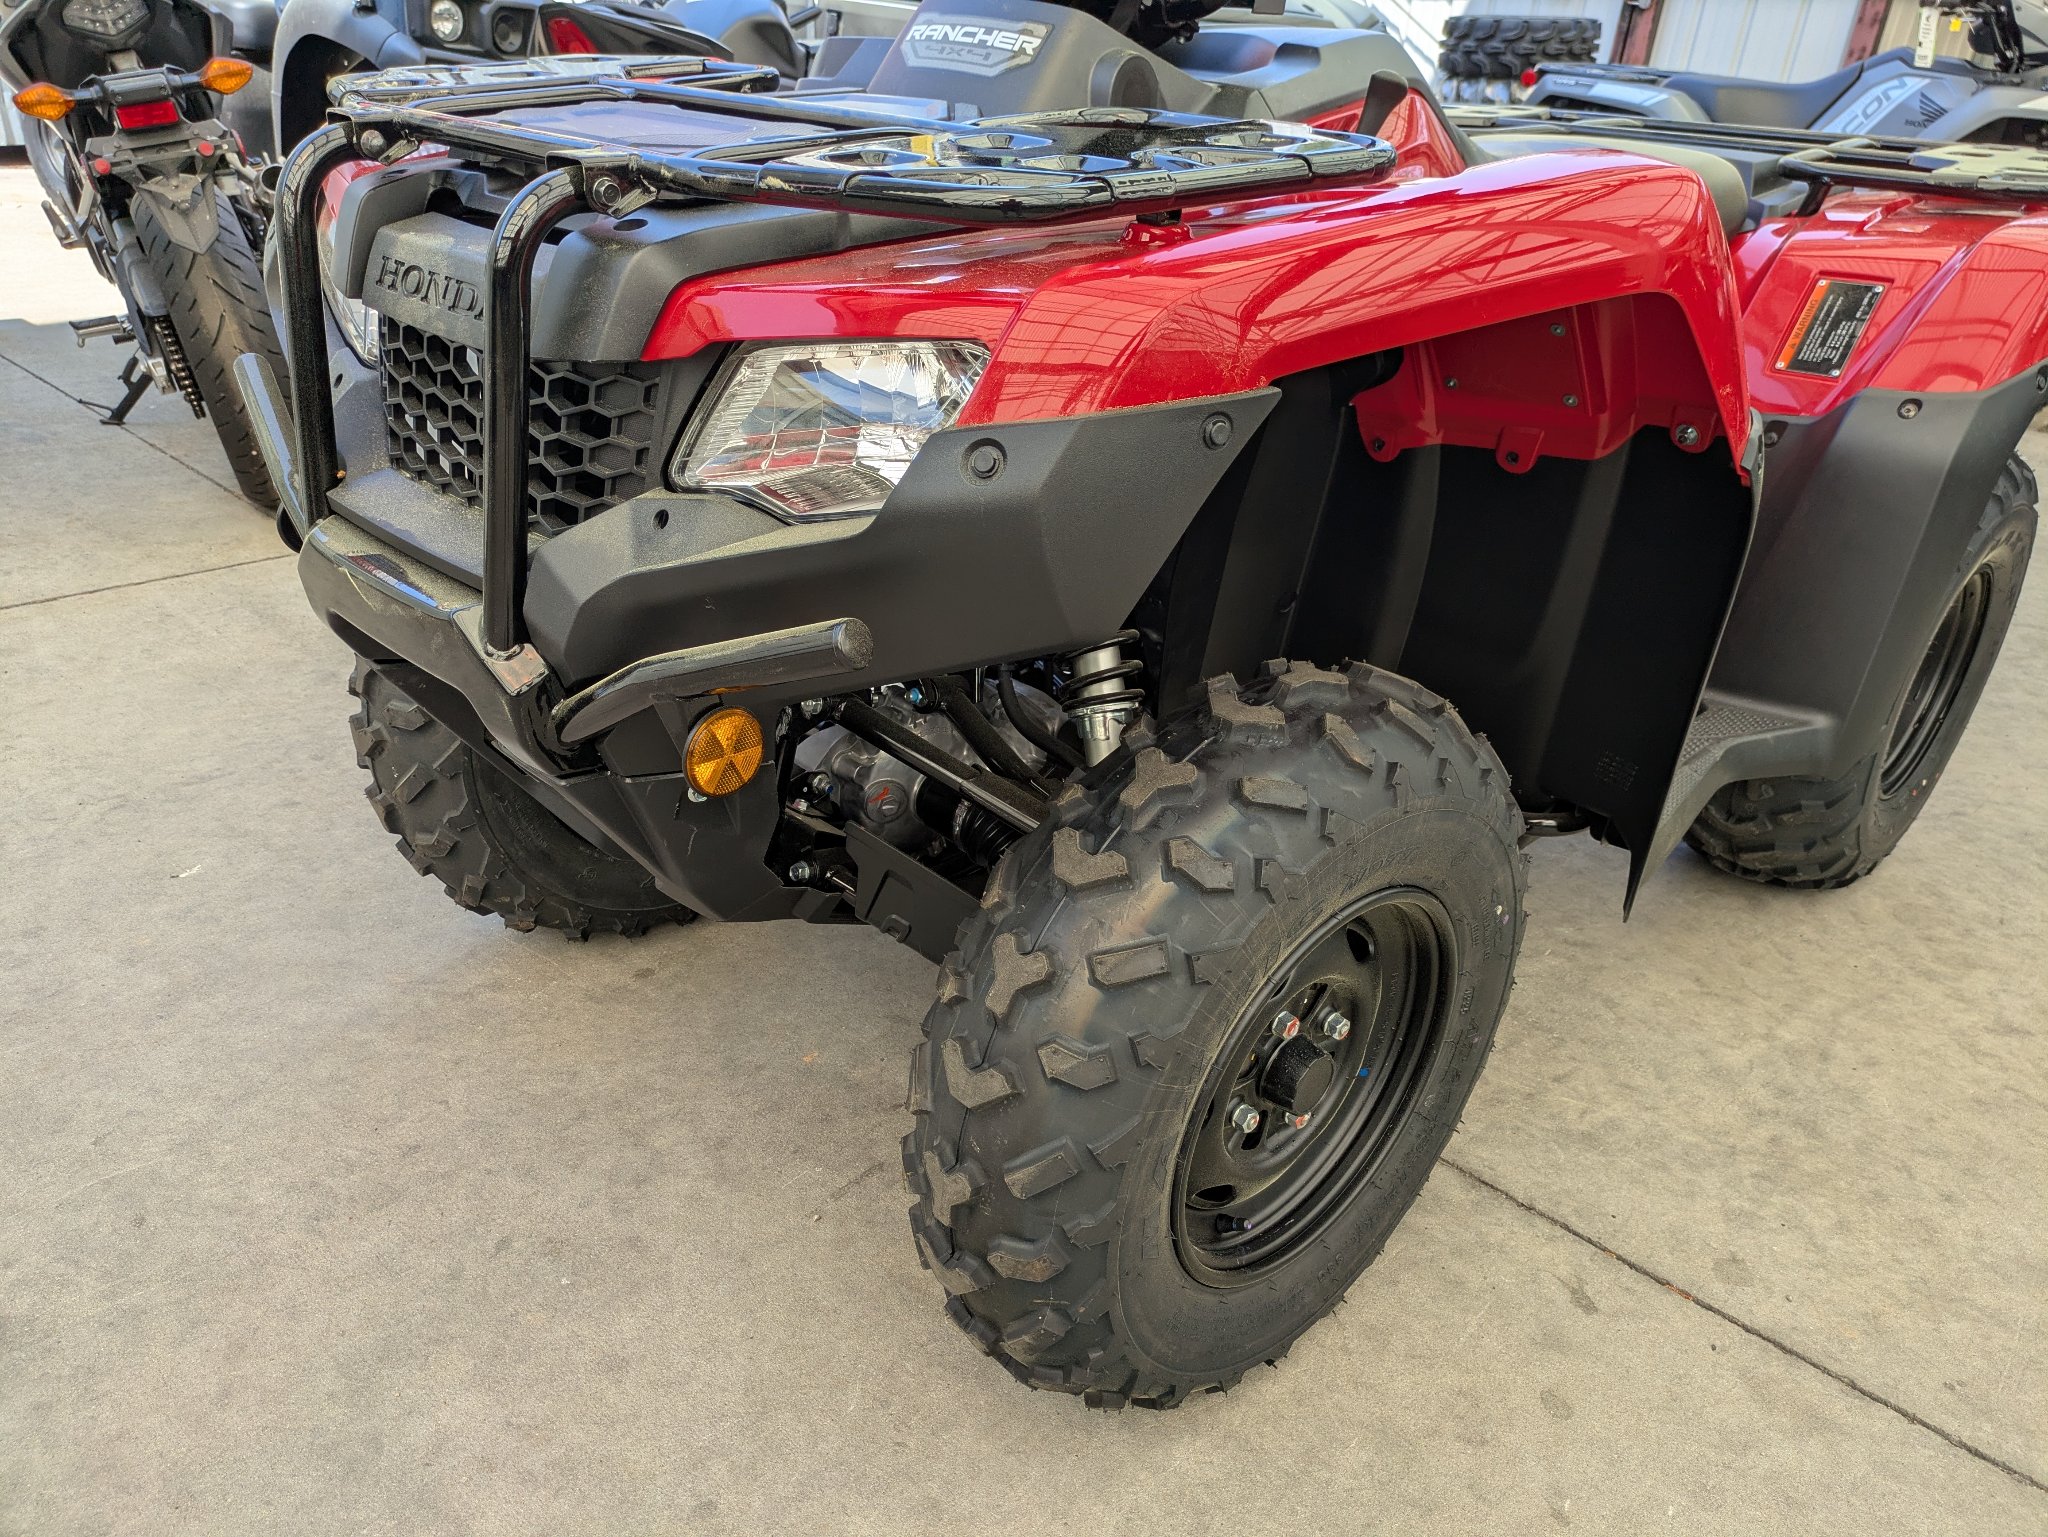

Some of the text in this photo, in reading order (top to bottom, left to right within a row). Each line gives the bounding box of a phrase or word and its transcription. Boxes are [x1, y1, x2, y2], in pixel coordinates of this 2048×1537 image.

[905, 24, 1042, 56] RANCHER
[375, 255, 484, 321] HOND
[1791, 297, 1819, 341] WARNING
